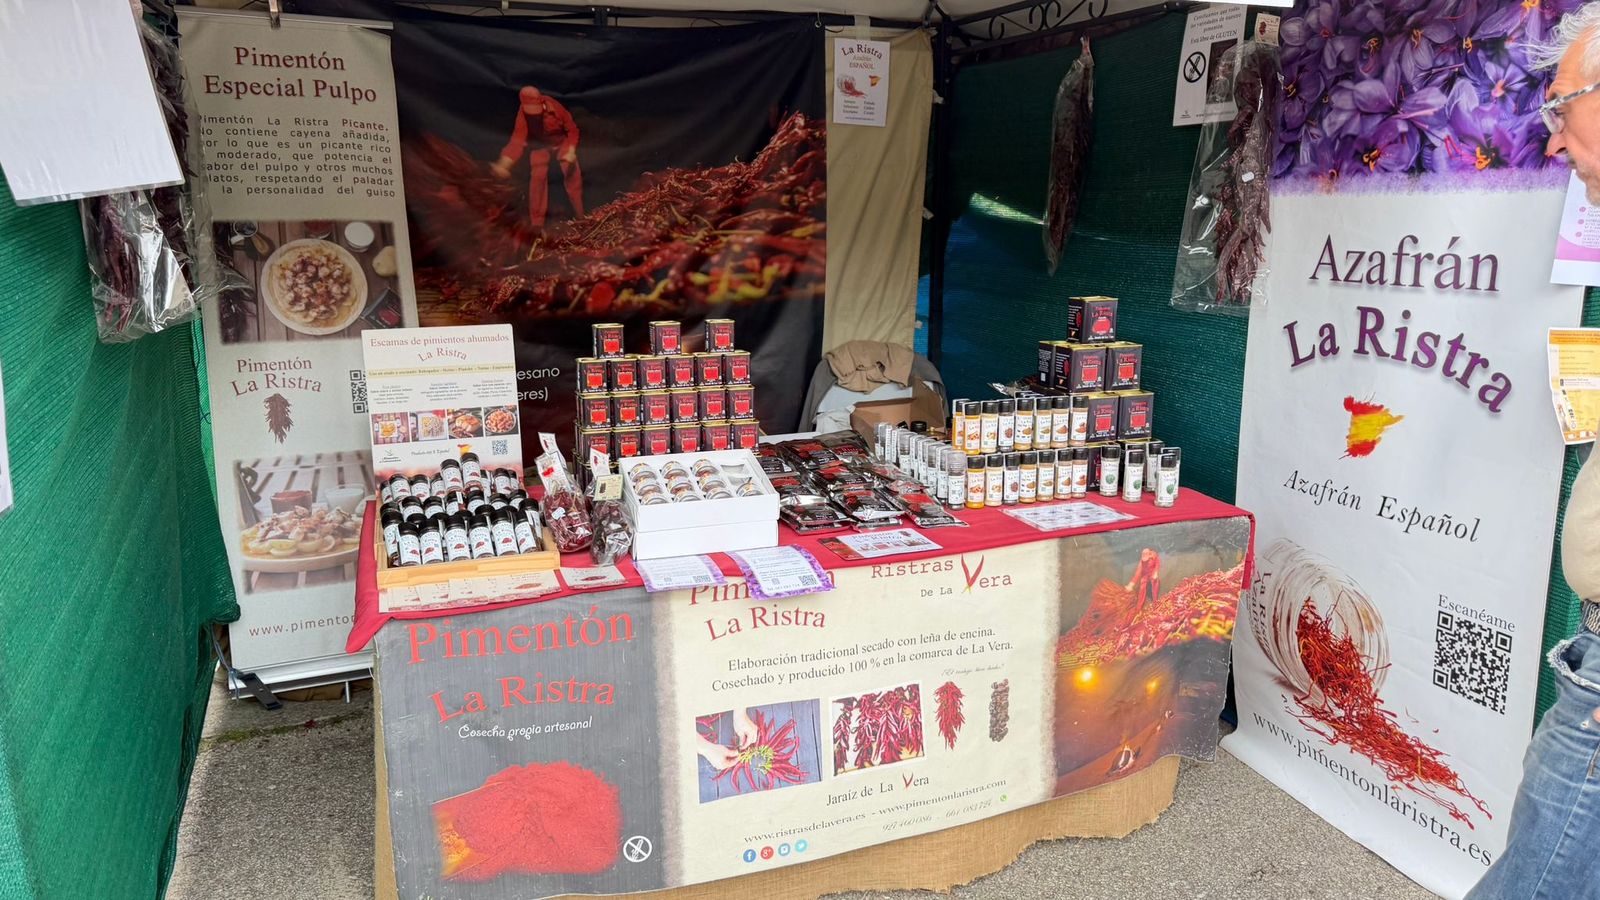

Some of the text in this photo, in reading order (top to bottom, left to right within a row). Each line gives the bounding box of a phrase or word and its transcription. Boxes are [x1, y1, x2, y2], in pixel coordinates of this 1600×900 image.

[234, 46, 345, 71] Pimentón
[842, 44, 882, 60] La Ristra
[204, 75, 376, 105] Especial Pulpo
[225, 128, 278, 137] contiene
[290, 130, 331, 139] cayena
[342, 130, 390, 143] añadida,
[268, 118, 281, 126] La
[295, 118, 329, 127] Ristra
[342, 118, 389, 132] Picante.
[201, 138, 391, 153] or lo que es un picante rico
[216, 151, 393, 164] moderado, que potencia el
[203, 174, 394, 187] latos, respetando el paladar
[240, 162, 259, 171] del
[265, 163, 298, 173] pulpo
[304, 165, 310, 173] y
[316, 164, 347, 172] otros
[352, 165, 394, 175] muchos
[222, 185, 396, 198] la personalidad del guiso
[1309, 234, 1500, 293] Azafrán
[370, 333, 510, 348] Escamas de pimientos ahumados
[237, 357, 312, 373] Pimentón
[418, 347, 468, 362] La Ristra
[1283, 305, 1513, 414] La Ristra
[231, 372, 322, 397] La Ristra
[517, 367, 560, 380] esano
[517, 386, 549, 402] eres)
[1283, 470, 1361, 511] Azafrán
[1377, 495, 1481, 543] Español
[871, 559, 954, 579] Ristras
[961, 553, 1013, 594] Vera
[920, 587, 953, 597] De La
[249, 613, 356, 636] www.pimento
[705, 604, 826, 641] La Ristra
[1438, 594, 1515, 633] Escanéame
[405, 605, 637, 664] Pimentón
[728, 627, 996, 671] Elaboración tradicional secado con leña de encina.
[712, 641, 1013, 692] Cosechado y producido 100 % en la comarca de La Vera.
[430, 672, 615, 723] La Ristra
[458, 722, 505, 739] Cosecha
[544, 716, 593, 734] artesanal
[826, 772, 929, 806] Jaraíz de La Vera
[1252, 711, 1492, 867] www.pimentonlaristra.es
[743, 812, 866, 844] www.ristrasdelavera.es
[879, 780, 1007, 815] www.pimentonlaristra.com
